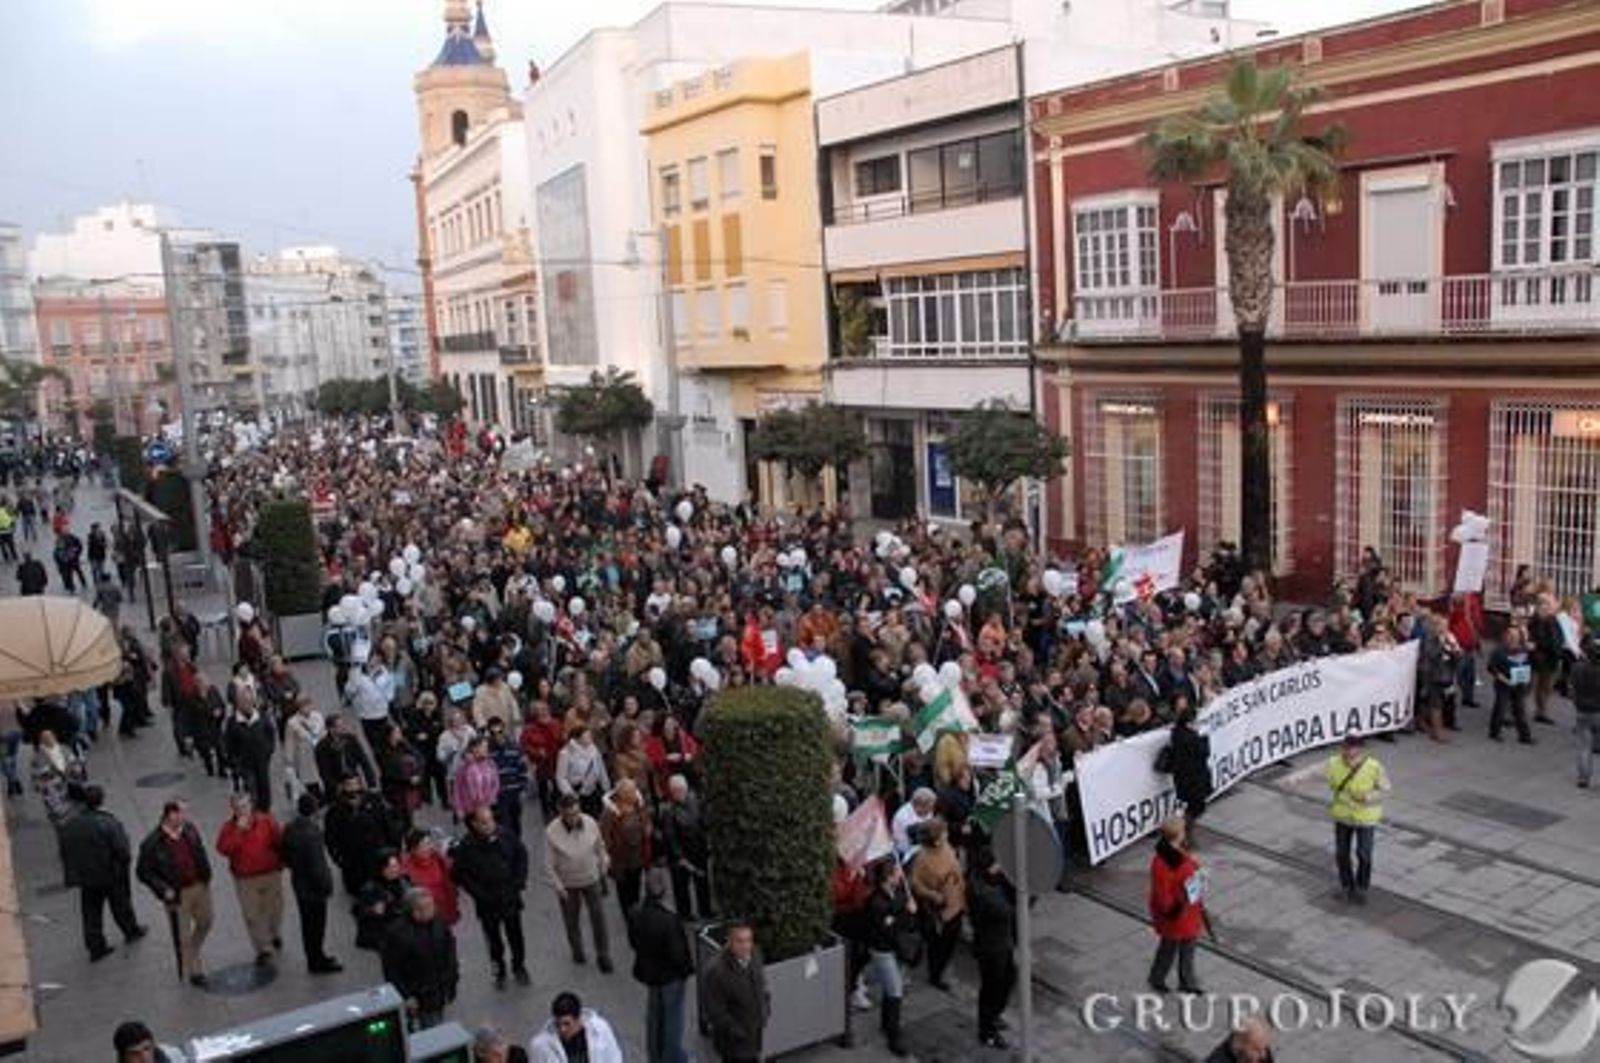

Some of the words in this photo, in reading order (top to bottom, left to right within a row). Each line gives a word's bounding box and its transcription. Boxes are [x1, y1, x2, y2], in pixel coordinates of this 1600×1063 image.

[1245, 688, 1267, 714] SAN
[1270, 670, 1323, 702] CARLOS
[1092, 789, 1183, 857] HOSPITA
[1268, 714, 1326, 757] PARA
[1330, 707, 1363, 737] LA
